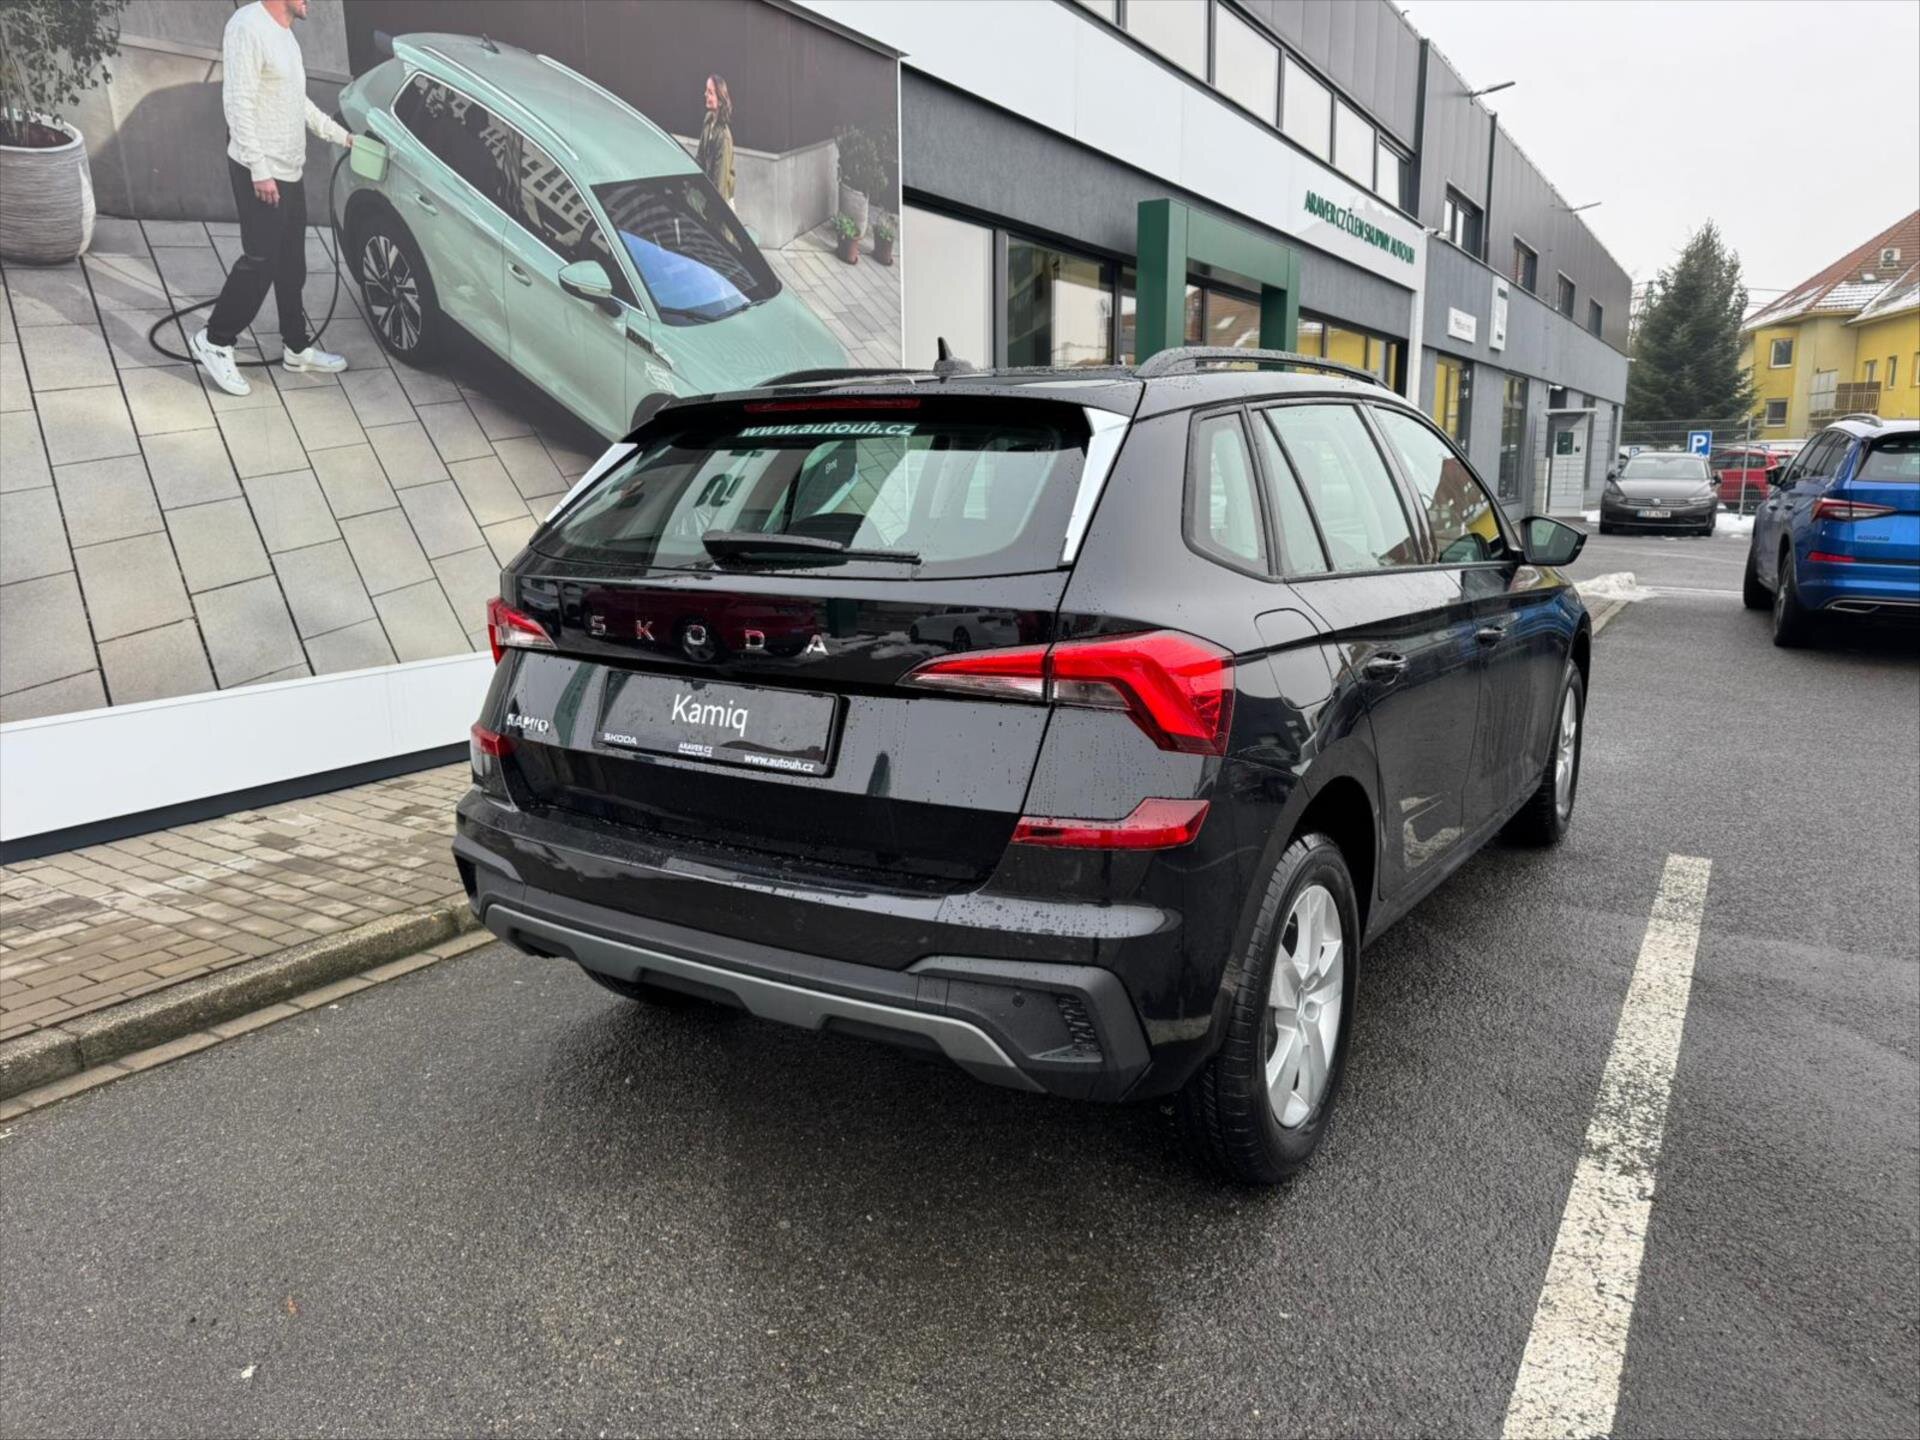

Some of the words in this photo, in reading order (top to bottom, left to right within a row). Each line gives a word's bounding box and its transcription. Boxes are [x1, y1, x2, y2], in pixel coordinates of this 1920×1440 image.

[1304, 190, 1336, 224] ARAVER
[1336, 207, 1346, 230] CZ
[741, 421, 917, 437] www.autouh.cz
[1691, 434, 1707, 454] P
[506, 713, 549, 733] KAMIQ
[671, 694, 748, 737] Kamiq
[744, 753, 814, 773] www.autouh.cz
